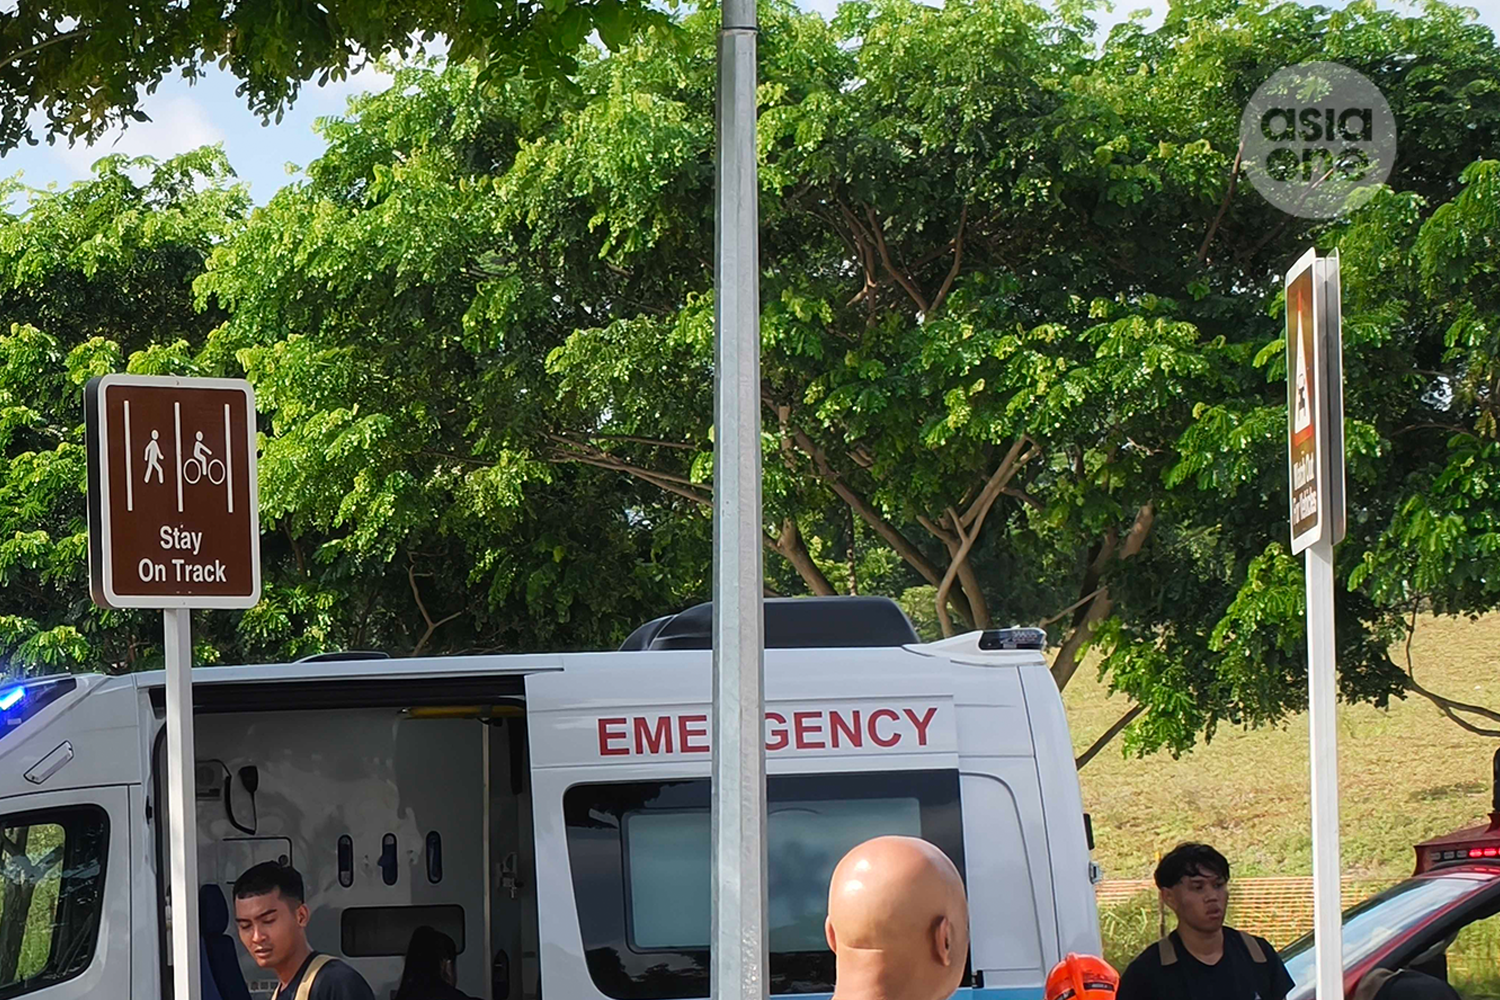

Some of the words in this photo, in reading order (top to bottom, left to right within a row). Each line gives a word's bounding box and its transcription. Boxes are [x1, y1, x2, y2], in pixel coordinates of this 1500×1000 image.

[160, 525, 202, 555] Stay
[138, 558, 166, 582] On
[171, 558, 227, 582] Track
[597, 707, 938, 756] EMEGENCY
